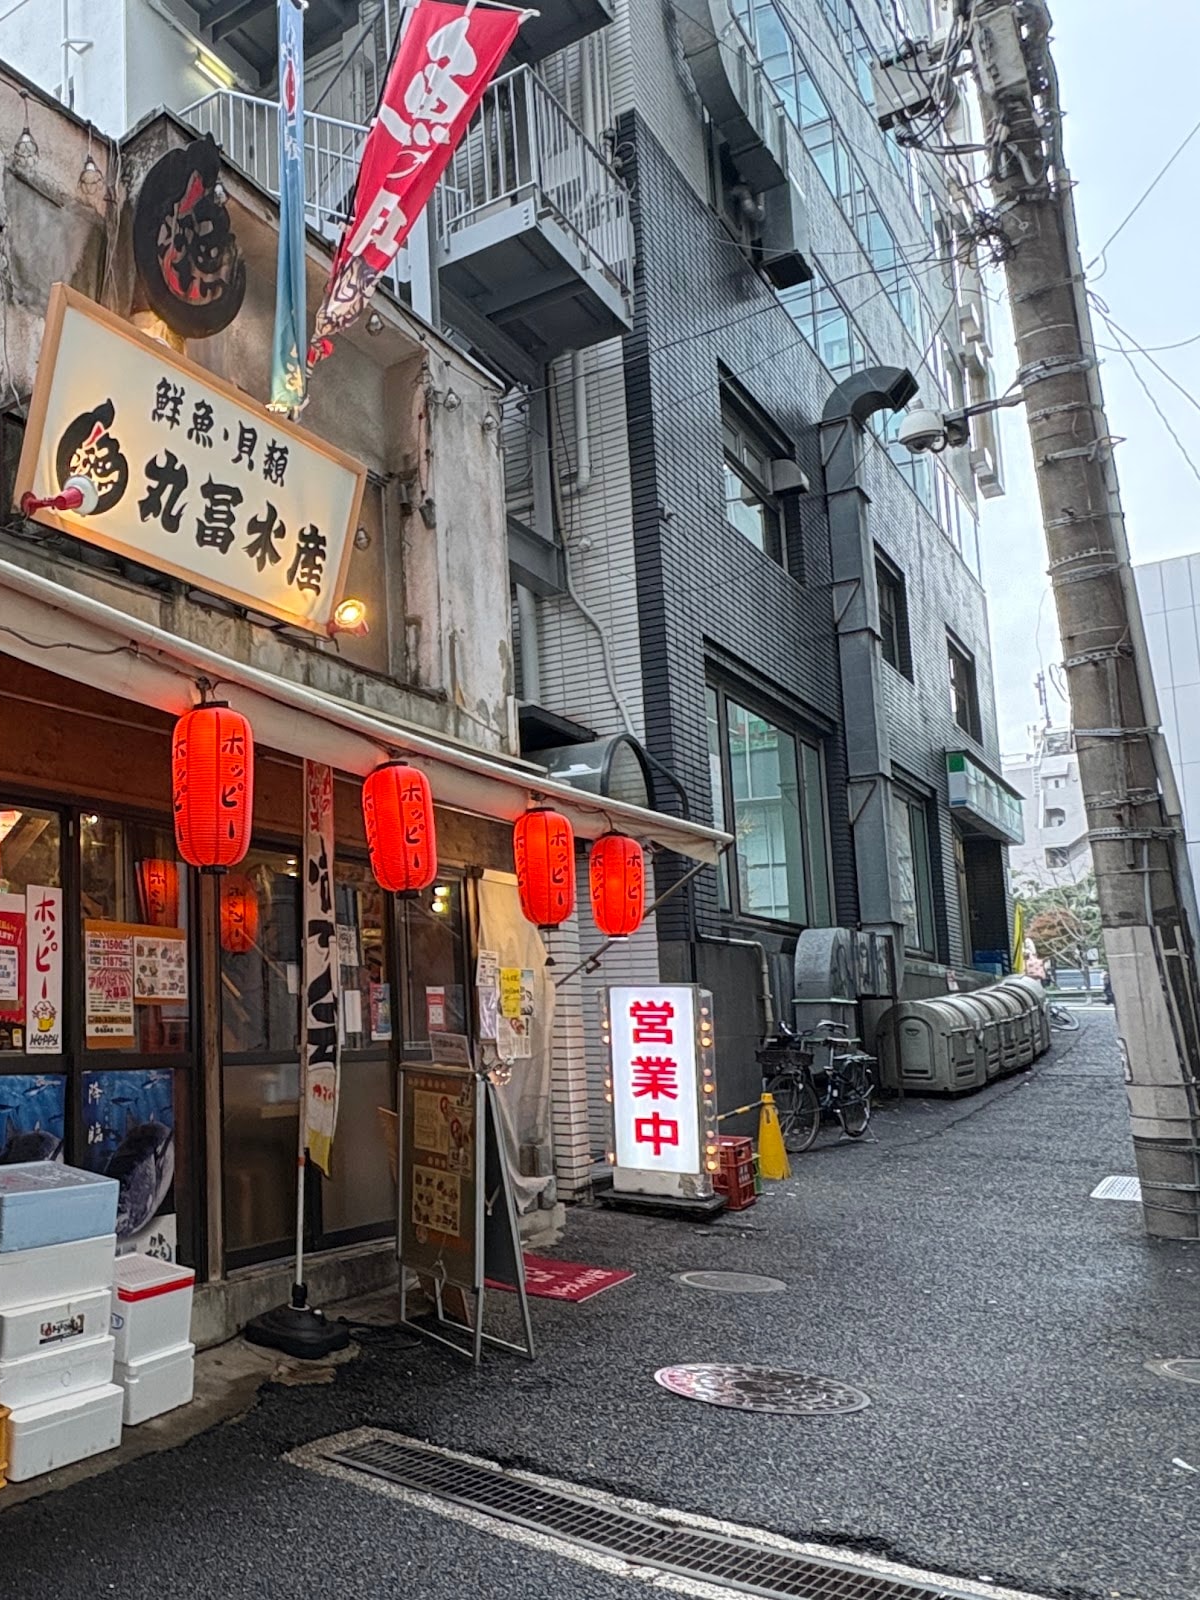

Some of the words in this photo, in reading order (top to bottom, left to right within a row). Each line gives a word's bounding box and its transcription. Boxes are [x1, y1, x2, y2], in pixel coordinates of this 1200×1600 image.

[221, 728, 244, 840] ホッピー
[401, 781, 426, 869] ホッピー
[549, 827, 570, 906] ホッピー
[627, 851, 642, 918] ホッピー
[33, 890, 58, 1000] ホッピー
[86, 1081, 104, 1145] 降臨
[629, 1000, 679, 1156] 営業中
